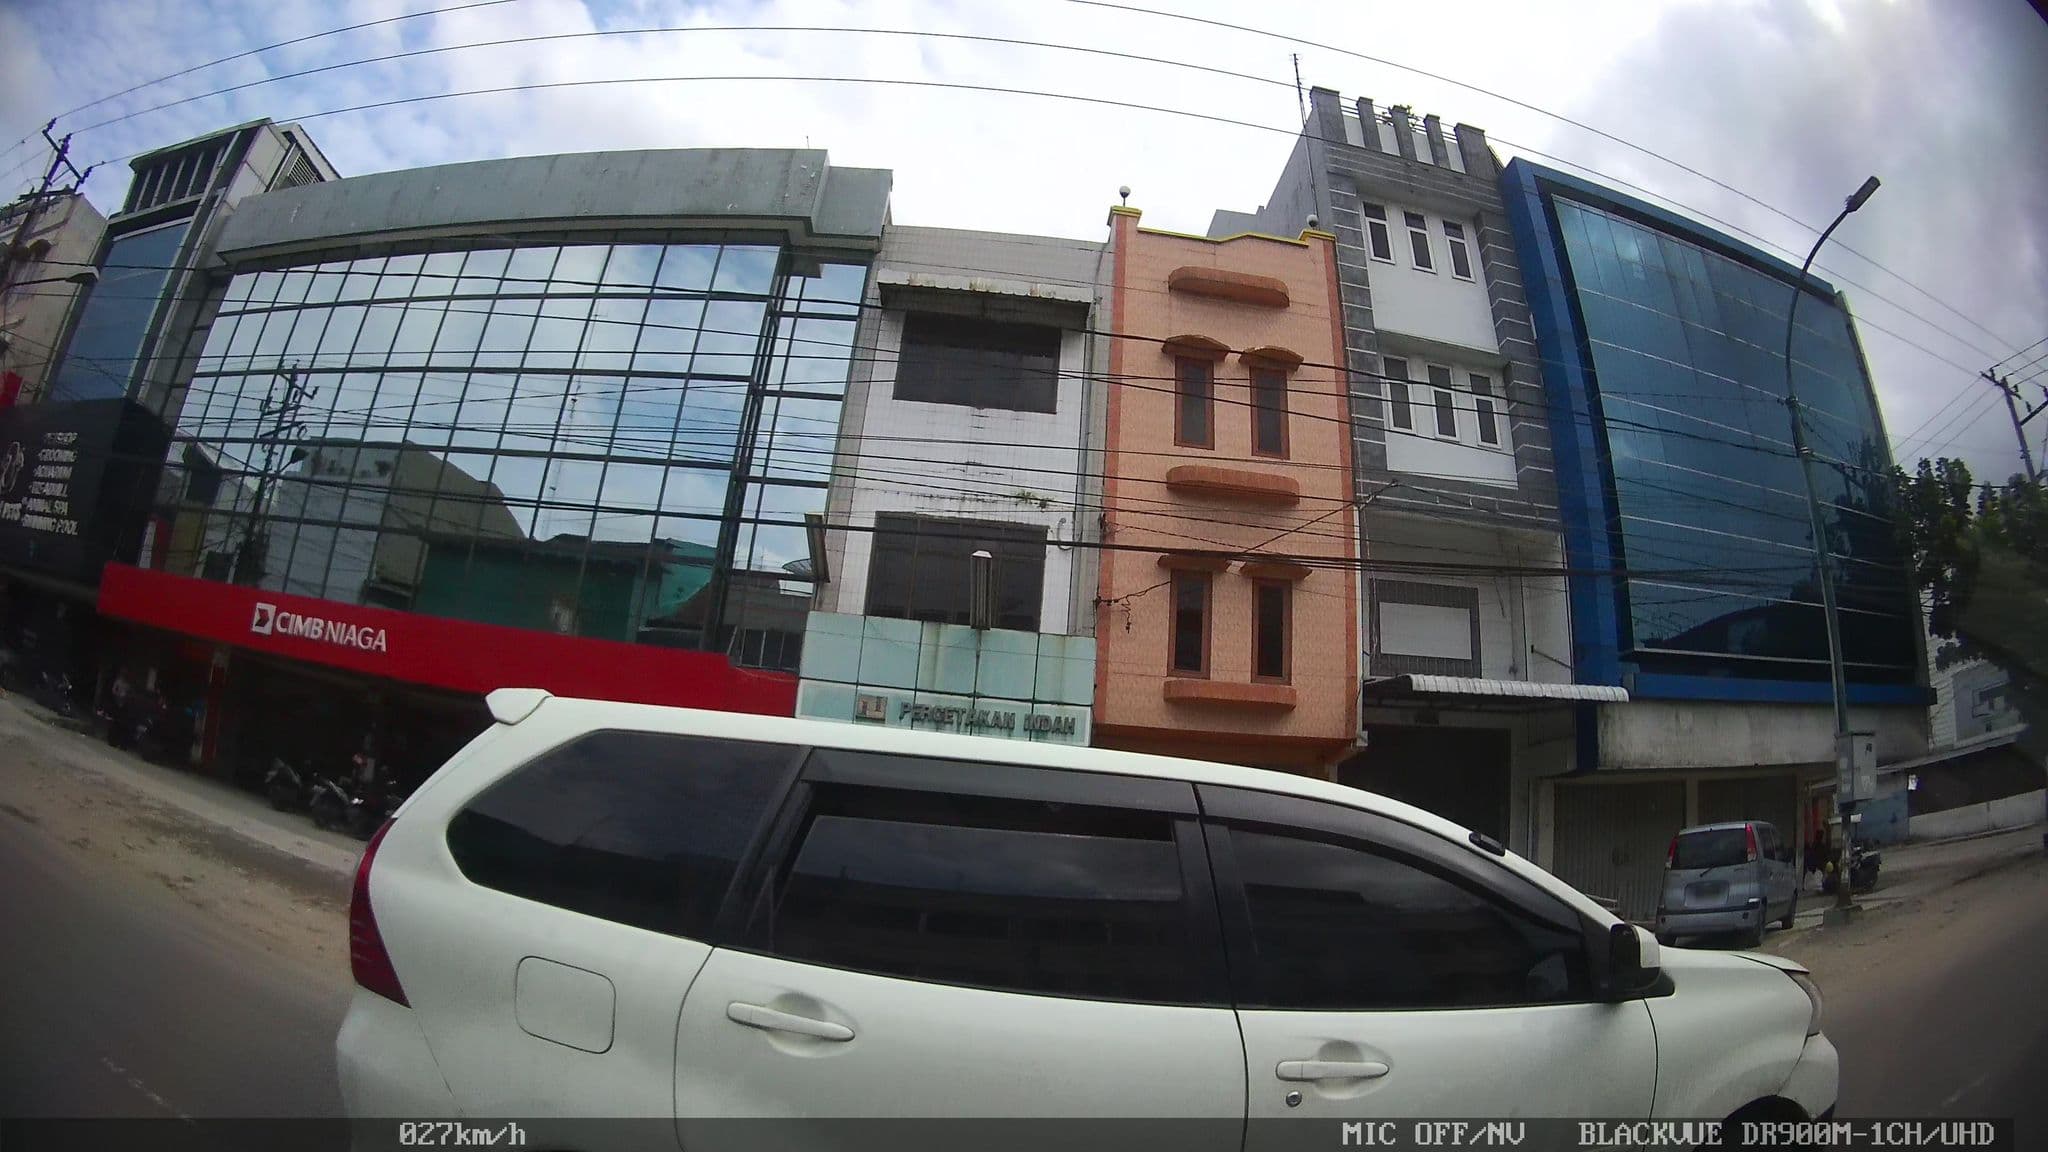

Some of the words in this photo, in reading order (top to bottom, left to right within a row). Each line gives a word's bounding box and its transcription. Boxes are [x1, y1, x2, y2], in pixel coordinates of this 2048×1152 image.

[276, 612, 324, 640] CIMB
[325, 621, 387, 652] NIAGA
[1023, 714, 1076, 735] INDAH
